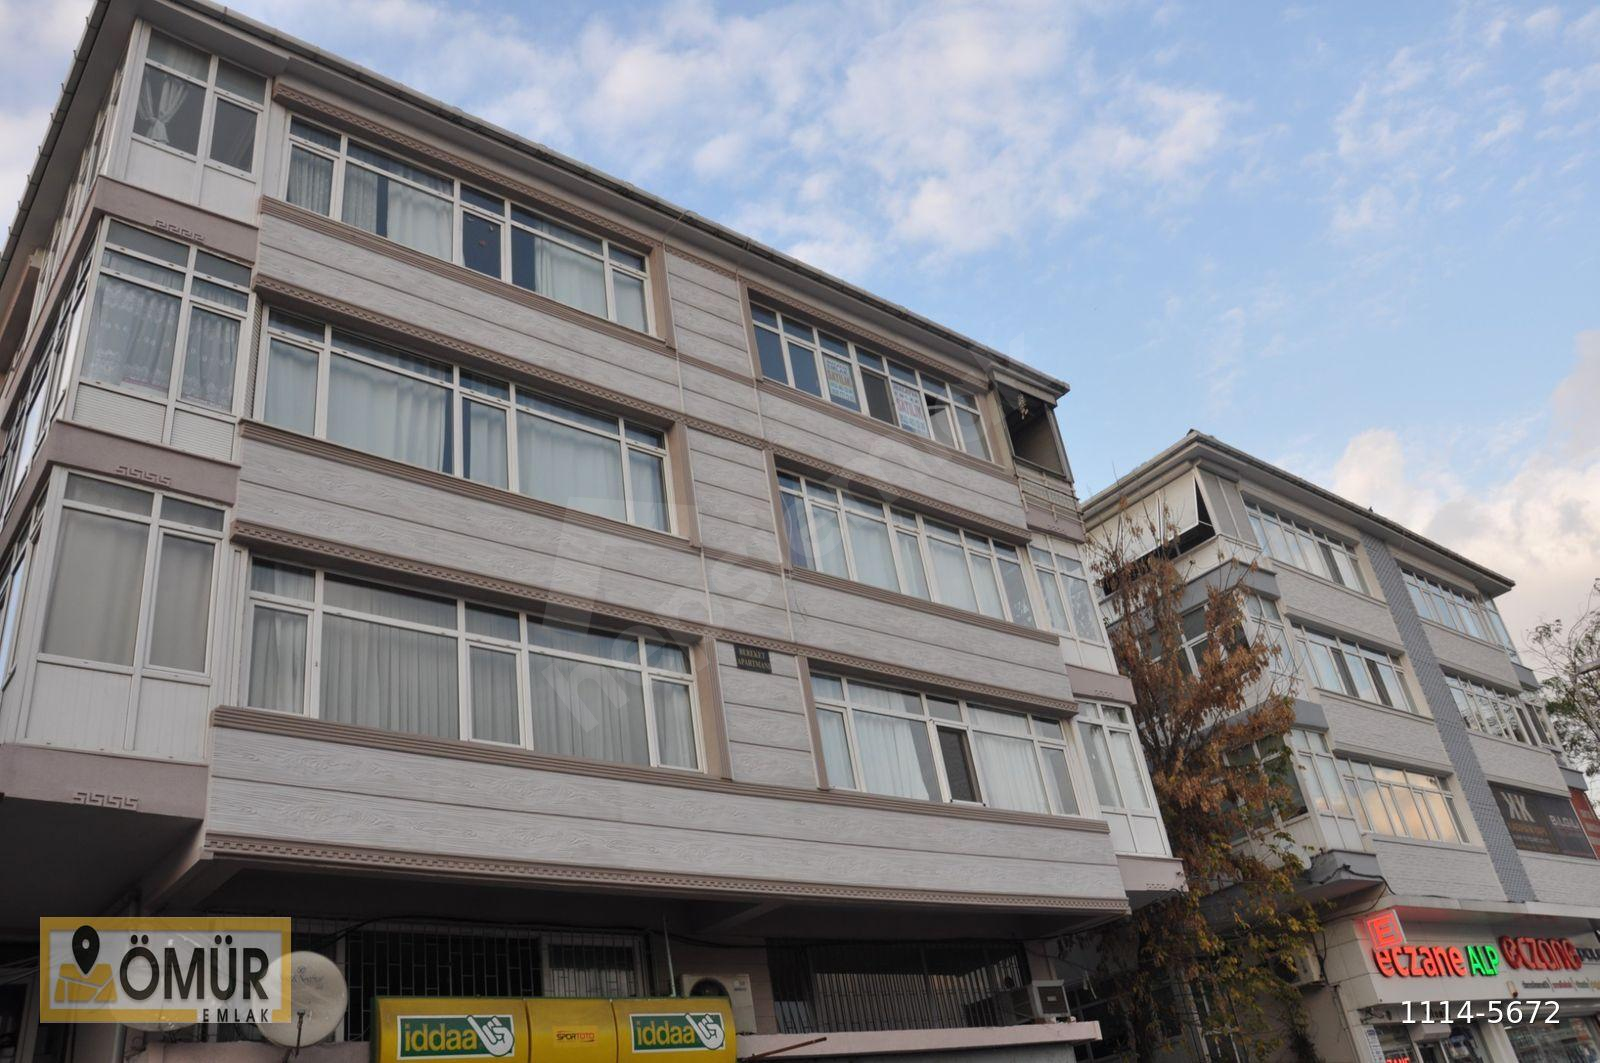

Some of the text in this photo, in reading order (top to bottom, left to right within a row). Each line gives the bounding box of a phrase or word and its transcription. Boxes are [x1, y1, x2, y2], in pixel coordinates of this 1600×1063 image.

[1373, 944, 1500, 977] eczane ALP
[1499, 935, 1582, 971] eczane
[404, 1022, 478, 1052] iddaa
[636, 1020, 696, 1048] iddaa
